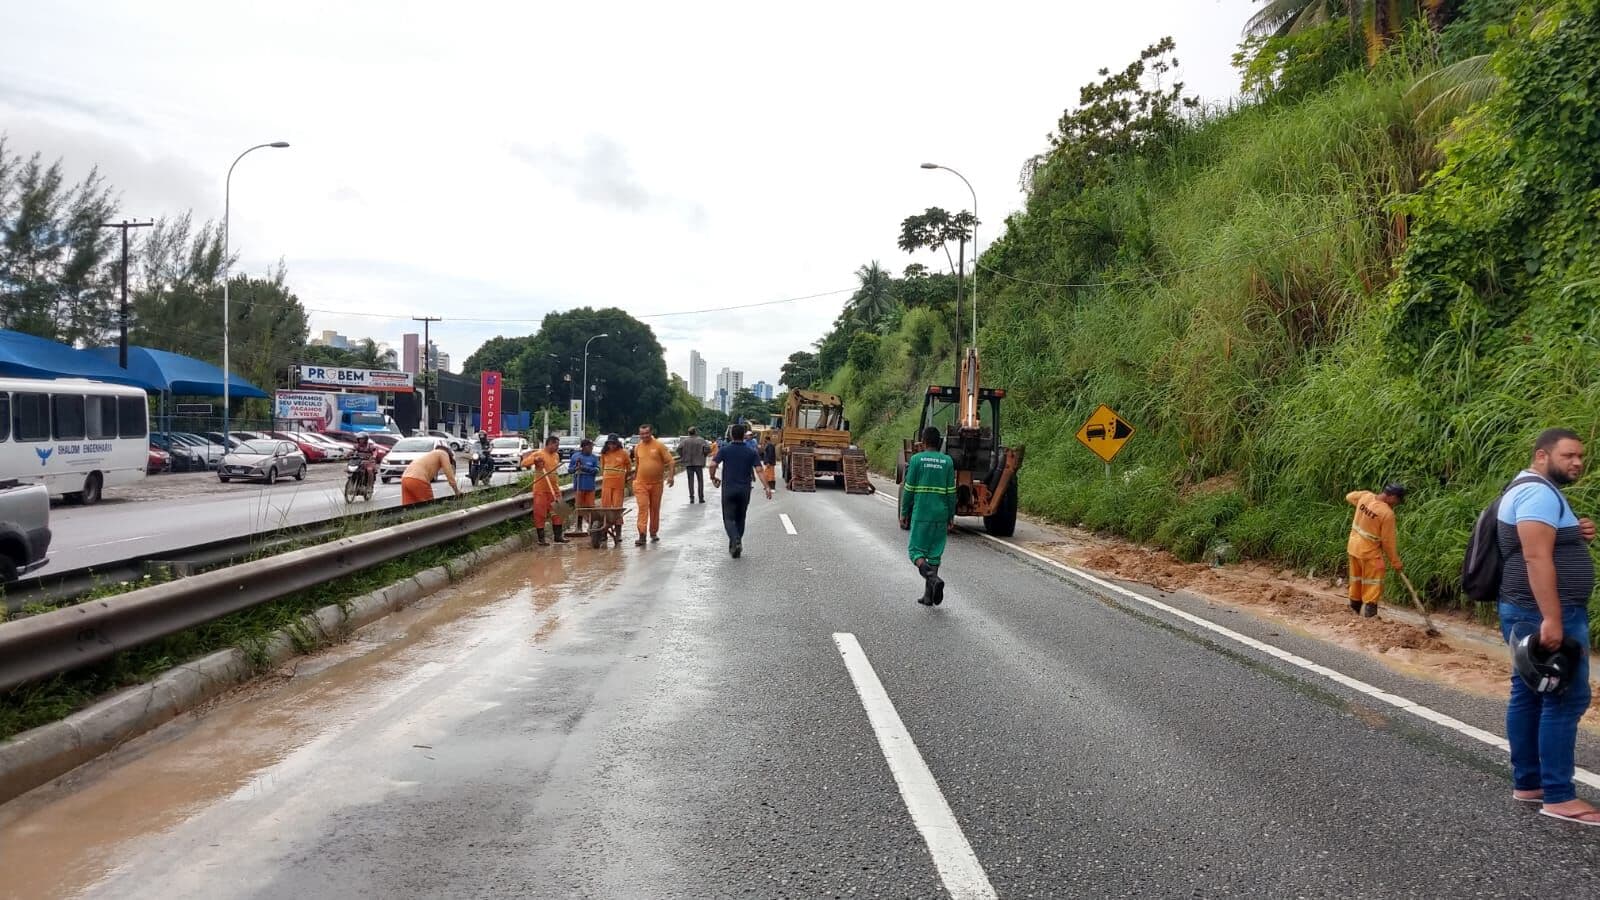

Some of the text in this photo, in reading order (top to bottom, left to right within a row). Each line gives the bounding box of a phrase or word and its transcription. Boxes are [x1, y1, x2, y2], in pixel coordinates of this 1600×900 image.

[487, 389, 495, 432] MOTORS
[57, 443, 113, 455] SHALOM ENGENHARIA
